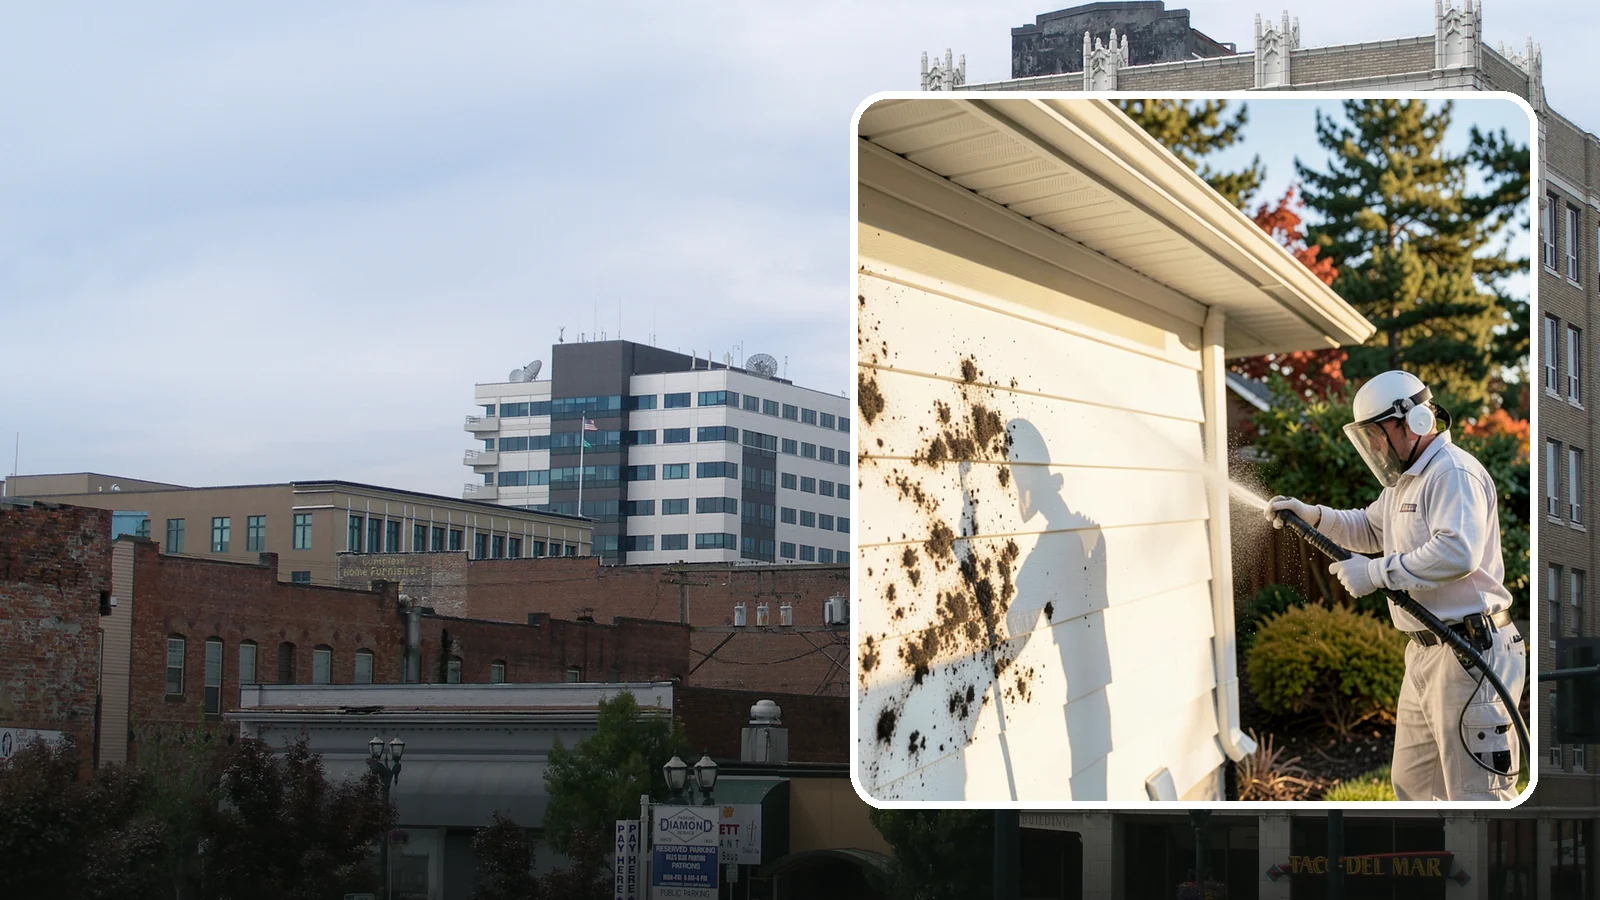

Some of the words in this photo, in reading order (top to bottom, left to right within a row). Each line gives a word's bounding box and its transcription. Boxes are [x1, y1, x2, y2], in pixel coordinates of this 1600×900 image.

[660, 818, 713, 832] DIAMOND
[1022, 816, 1069, 828] BUILDING
[722, 852, 739, 862] Soup
[1344, 856, 1385, 875] DEL
[1392, 857, 1442, 876] MAR
[628, 856, 636, 893] HERE
